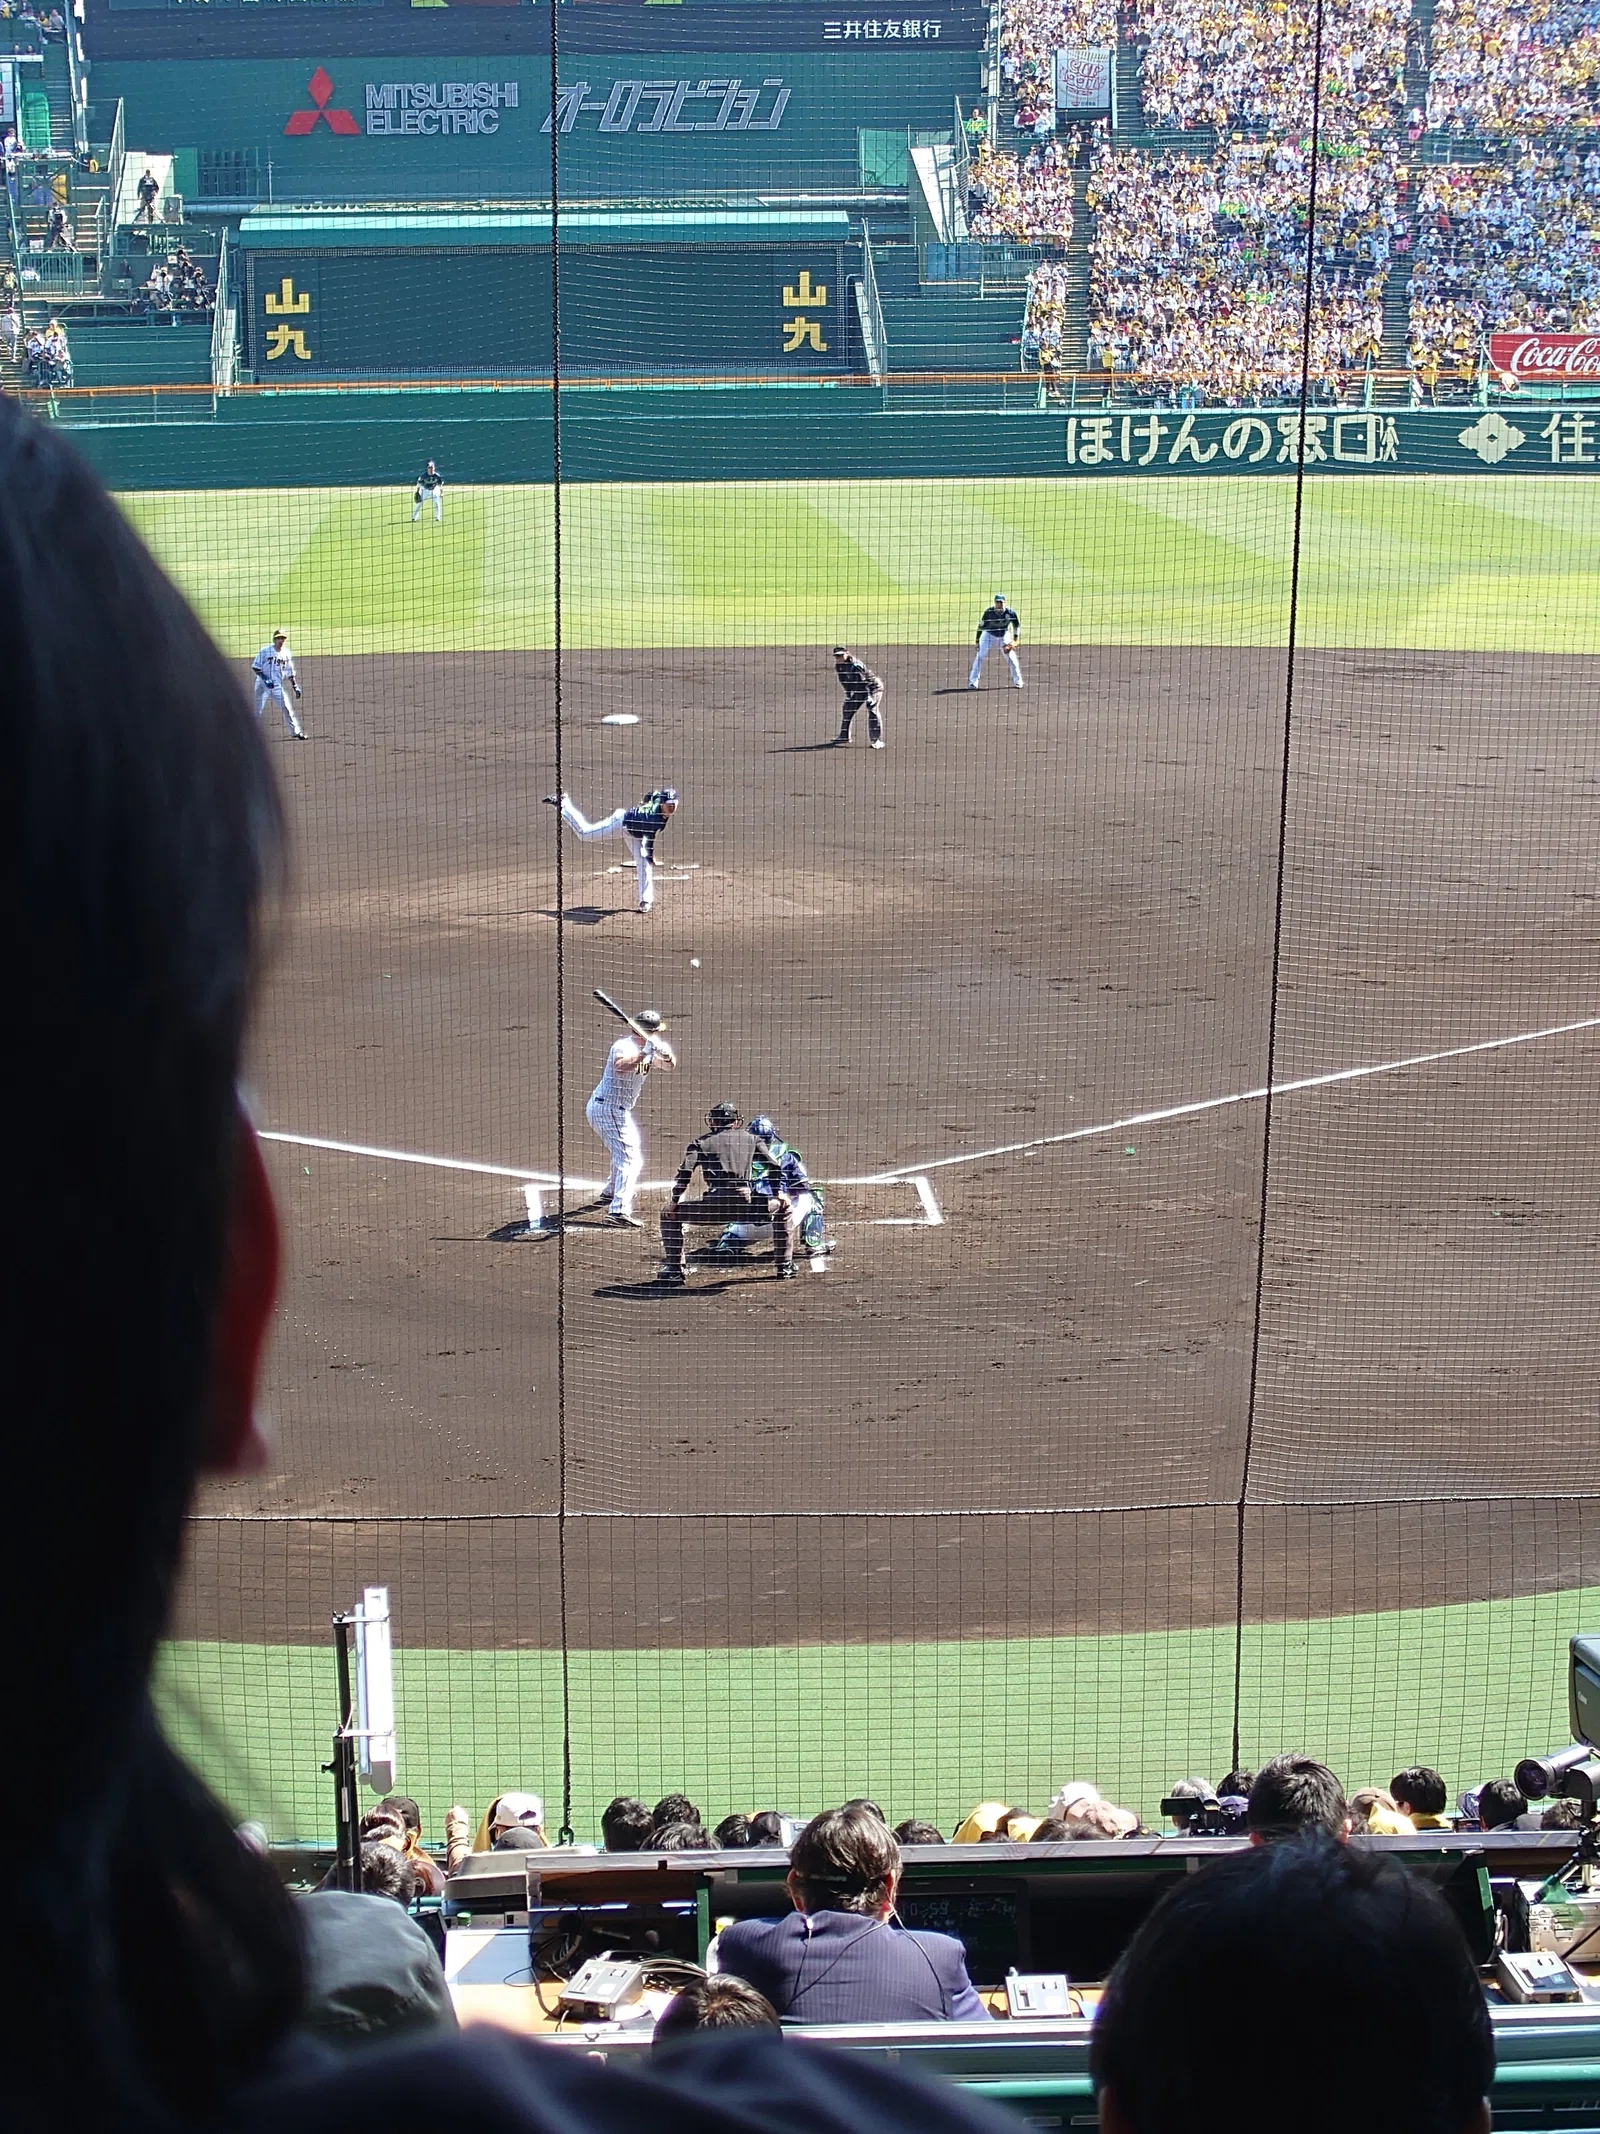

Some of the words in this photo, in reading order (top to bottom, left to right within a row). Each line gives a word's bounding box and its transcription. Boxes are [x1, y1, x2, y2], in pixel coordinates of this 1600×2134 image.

[823, 19, 942, 39] 三井住友銀行
[365, 82, 519, 109] MITSUBISHI
[540, 79, 791, 133] オーロラビジョン
[366, 109, 500, 135] ELECTRIC
[265, 278, 312, 360] 山九
[782, 271, 828, 353] 山九
[1510, 337, 1600, 376] Coca-Co
[1067, 413, 1383, 466] ほけんの窓口
